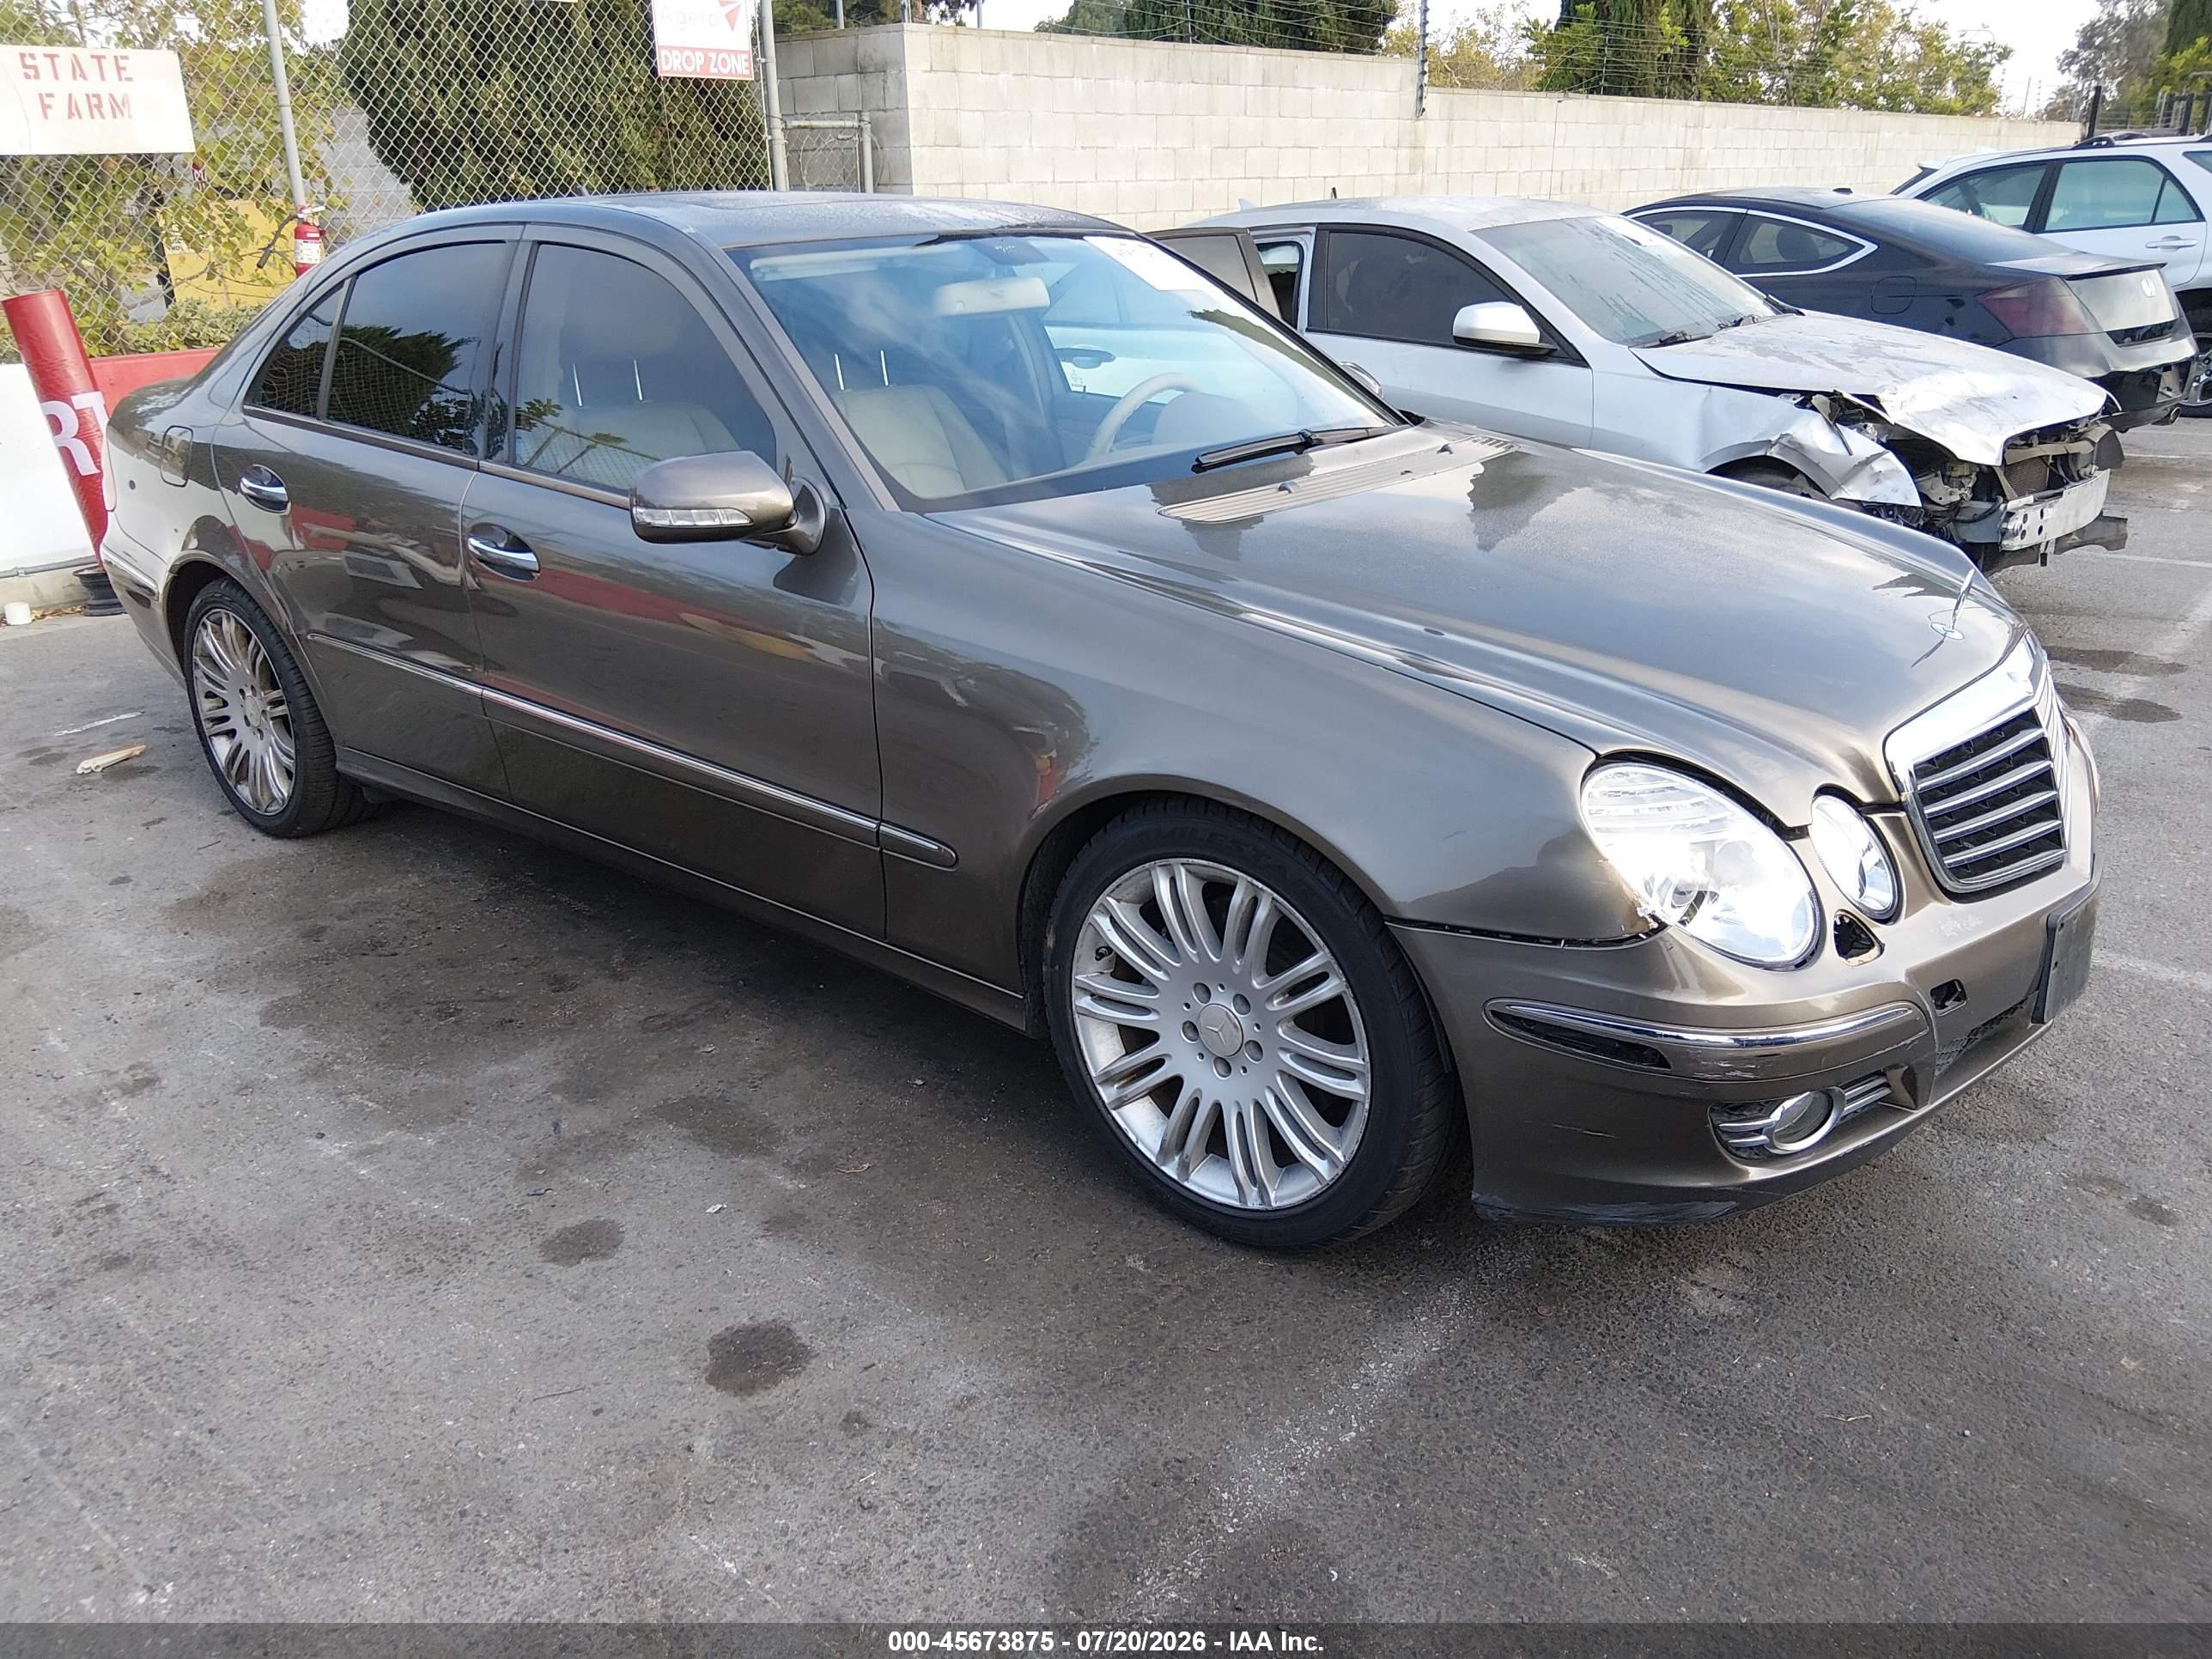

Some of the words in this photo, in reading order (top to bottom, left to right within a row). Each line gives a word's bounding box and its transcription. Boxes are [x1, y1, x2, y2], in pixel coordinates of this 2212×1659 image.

[19, 52, 134, 82] STATE
[660, 50, 704, 72] DROP
[709, 52, 750, 75] ZONE
[38, 92, 133, 120] FARM
